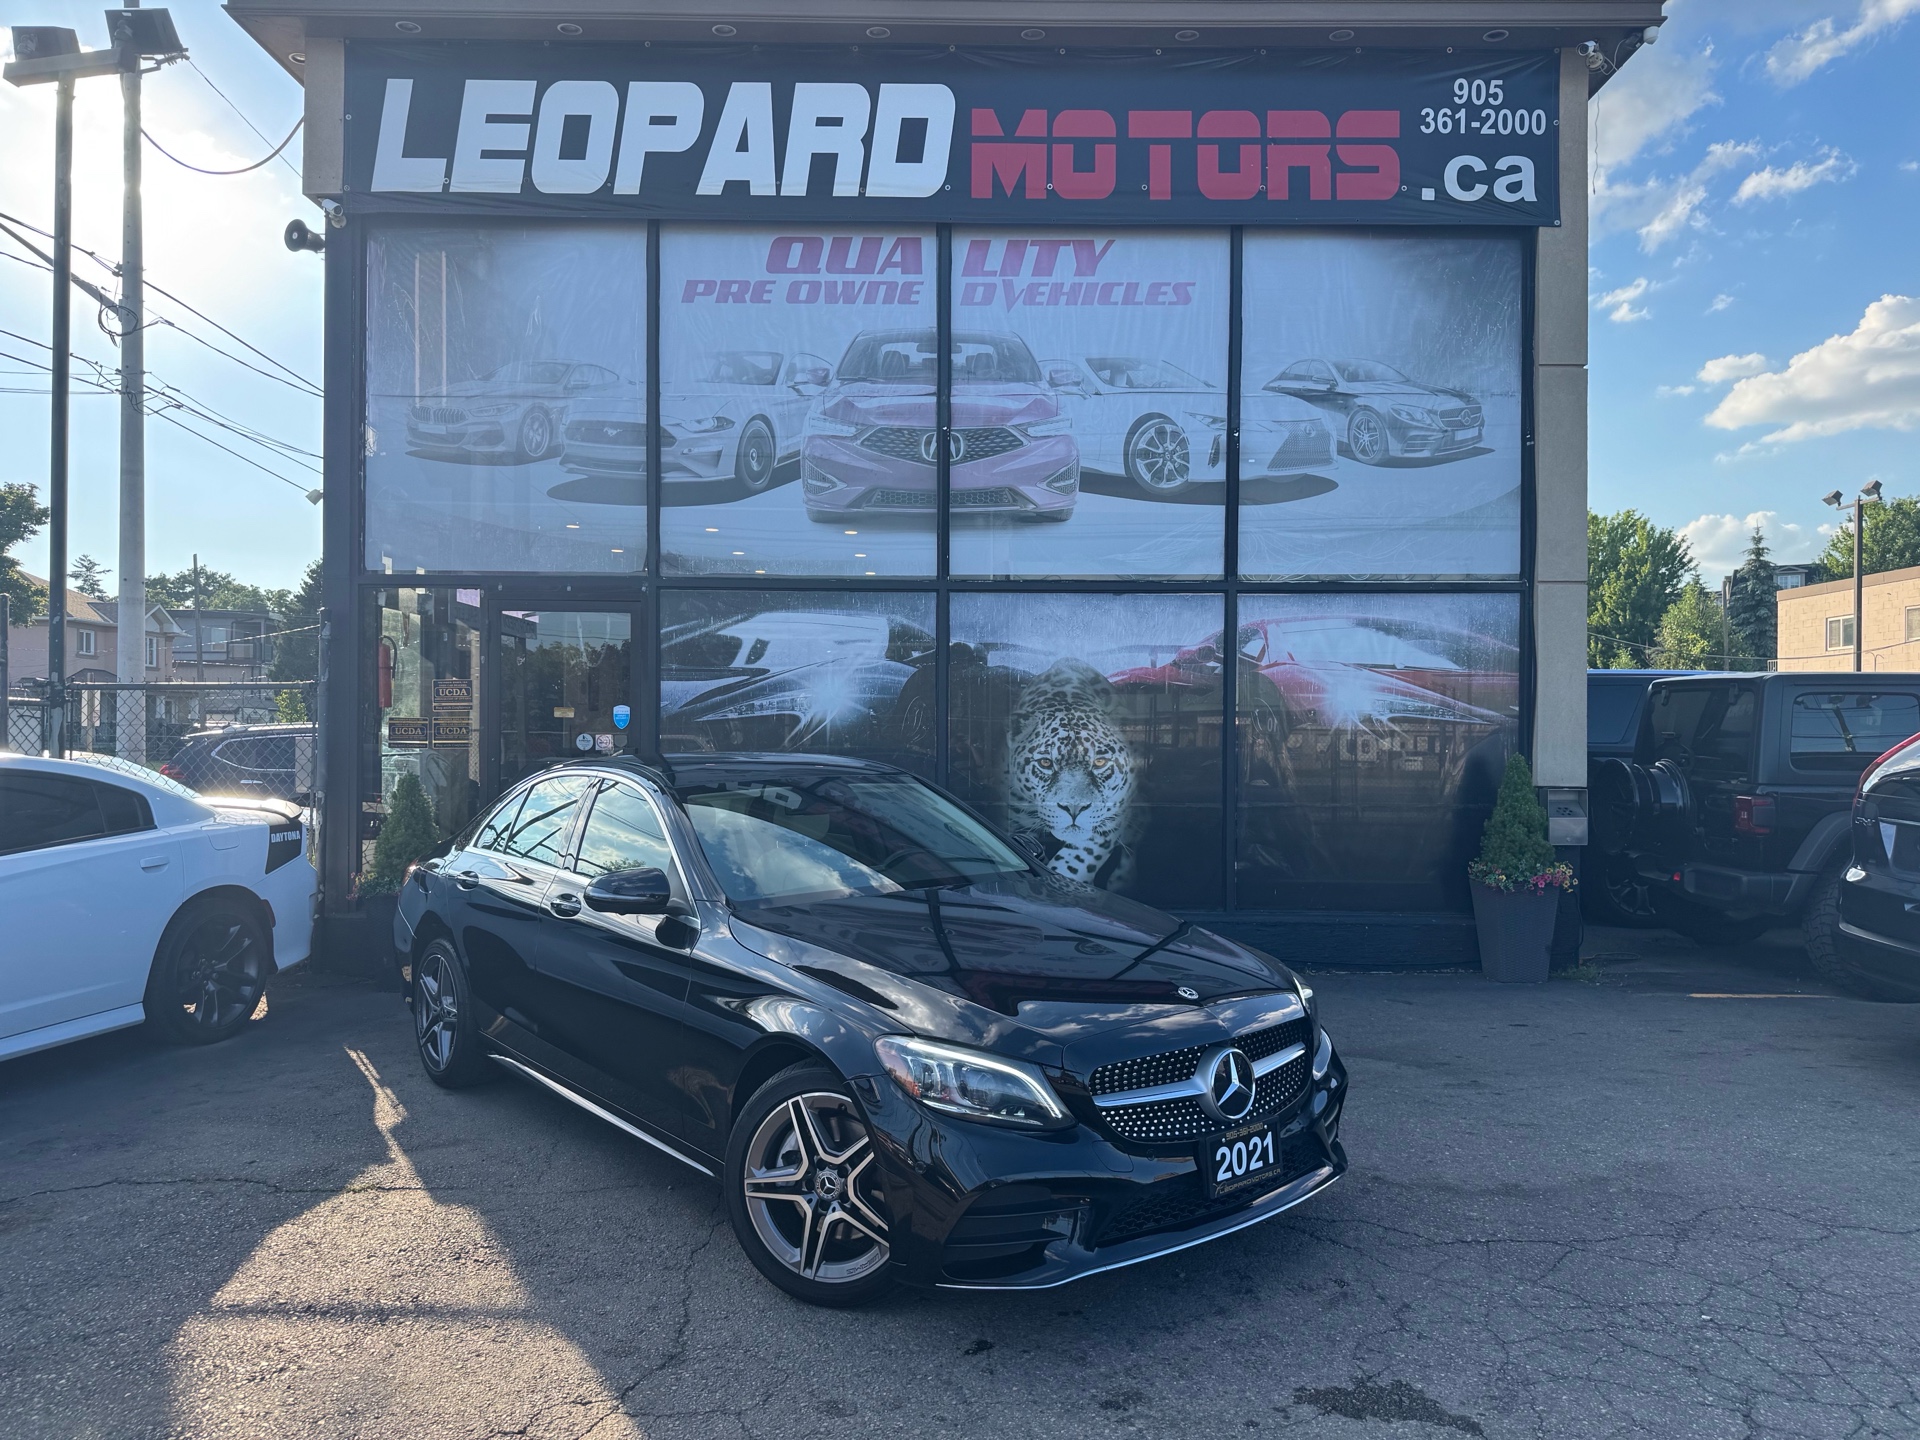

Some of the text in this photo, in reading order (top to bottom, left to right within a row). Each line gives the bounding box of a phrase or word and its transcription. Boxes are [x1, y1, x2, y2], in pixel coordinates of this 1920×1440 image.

[1453, 78, 1504, 106] 905
[1420, 108, 1547, 135] 361-2000
[370, 78, 1400, 200] LEOPARD MOTORS
[1421, 154, 1537, 203] .ca
[765, 236, 1116, 278] QUA LITY
[681, 279, 774, 305] PRE
[395, 727, 422, 735] UCDA
[440, 727, 467, 735] UCDA
[271, 830, 301, 843] DAYTONA
[1226, 1122, 1263, 1140] 905-361-2000
[1216, 1131, 1274, 1182] 2021
